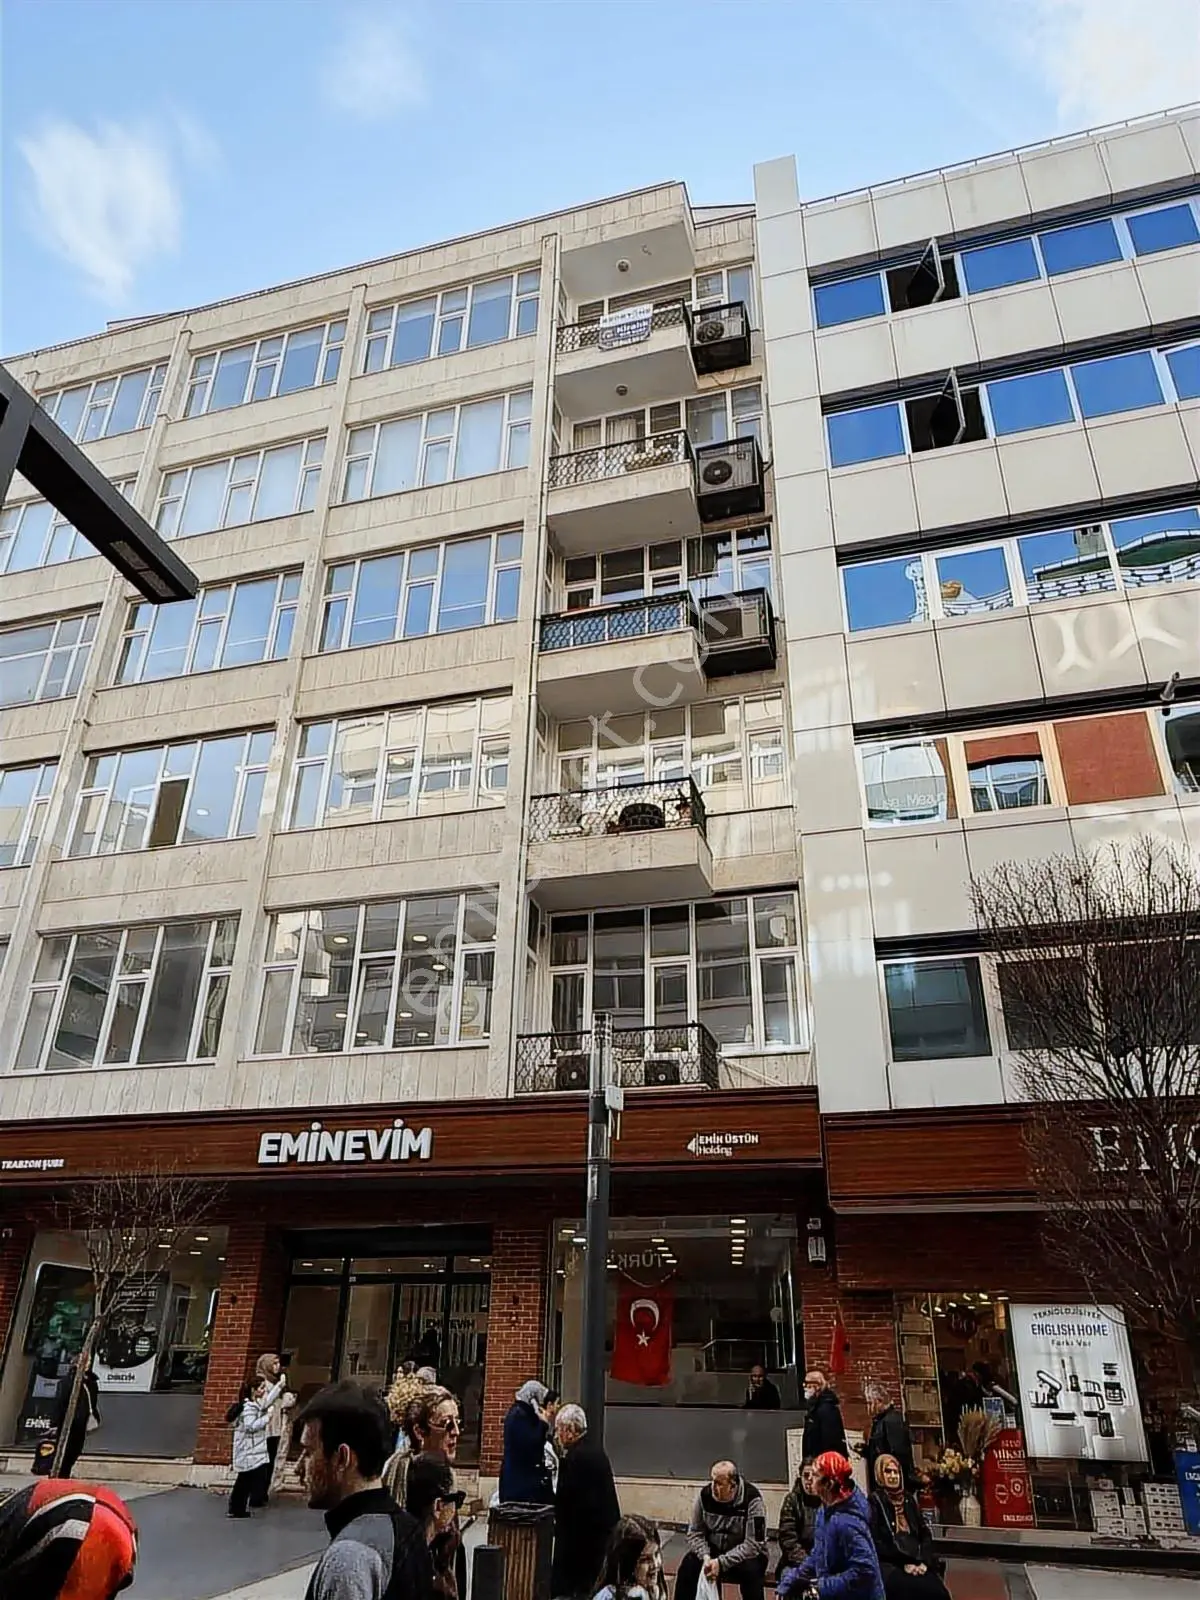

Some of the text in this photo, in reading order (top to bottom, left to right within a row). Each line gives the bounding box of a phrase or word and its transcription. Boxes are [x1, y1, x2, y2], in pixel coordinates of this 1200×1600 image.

[257, 1118, 433, 1164] EMİNEVİM
[699, 1132, 759, 1145] EMİN ÜSTÜN
[699, 1145, 732, 1157] Holding
[1030, 1323, 1109, 1336] ENGLISH HOME
